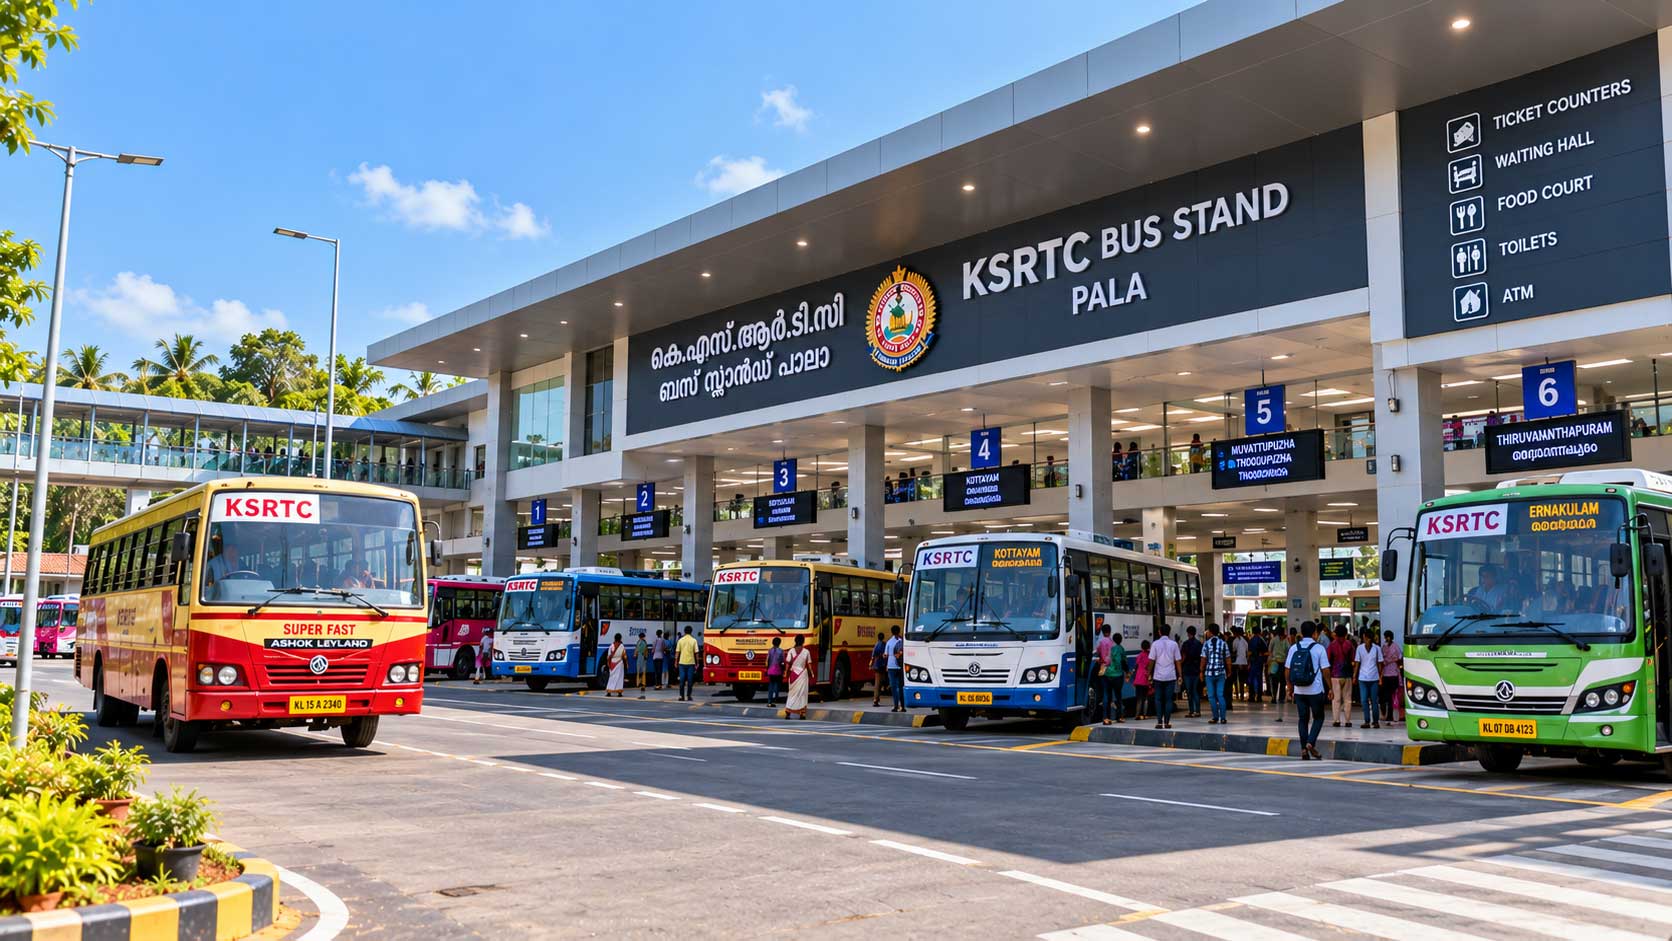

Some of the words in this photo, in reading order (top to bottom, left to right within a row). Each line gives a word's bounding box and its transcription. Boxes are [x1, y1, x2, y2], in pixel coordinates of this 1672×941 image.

[1493, 104, 1543, 130] TICKET
[1547, 79, 1631, 115] COUNTERS
[1495, 142, 1554, 169] WAITING
[1558, 130, 1594, 153] HALL
[1497, 189, 1537, 211] FOOD
[1542, 175, 1593, 200] COURT
[962, 231, 1091, 300] KSRTC
[1101, 215, 1161, 259] BUS
[1172, 182, 1289, 241] STAND
[1499, 231, 1558, 256] TOILETS
[1072, 271, 1147, 315] PALA
[1502, 284, 1534, 303] ATM
[659, 368, 701, 402] ബസ്
[778, 346, 830, 377] പാലാ
[1538, 377, 1559, 407] 6
[1256, 399, 1272, 425] 5
[978, 438, 990, 460] 4
[779, 468, 788, 487] 3
[225, 498, 312, 518] KSRTC
[640, 490, 648, 507] 2
[535, 505, 540, 521] 1
[1529, 502, 1599, 518] ERNAKULAM
[1426, 510, 1500, 535] KSRTC
[923, 550, 973, 566] KSRTC
[994, 547, 1041, 559] KOTTAYAM
[718, 571, 758, 583] KSRTC
[283, 624, 322, 636] SUPER
[327, 624, 356, 636] FAST
[270, 639, 313, 648] ASHOK
[317, 640, 368, 648] LEYLAND
[294, 700, 304, 710] KL
[306, 700, 314, 710] 15
[315, 700, 322, 709] A
[323, 700, 341, 709] 2340
[1482, 723, 1493, 733] KL
[1494, 723, 1503, 733] 07
[1516, 724, 1534, 735] 4123
